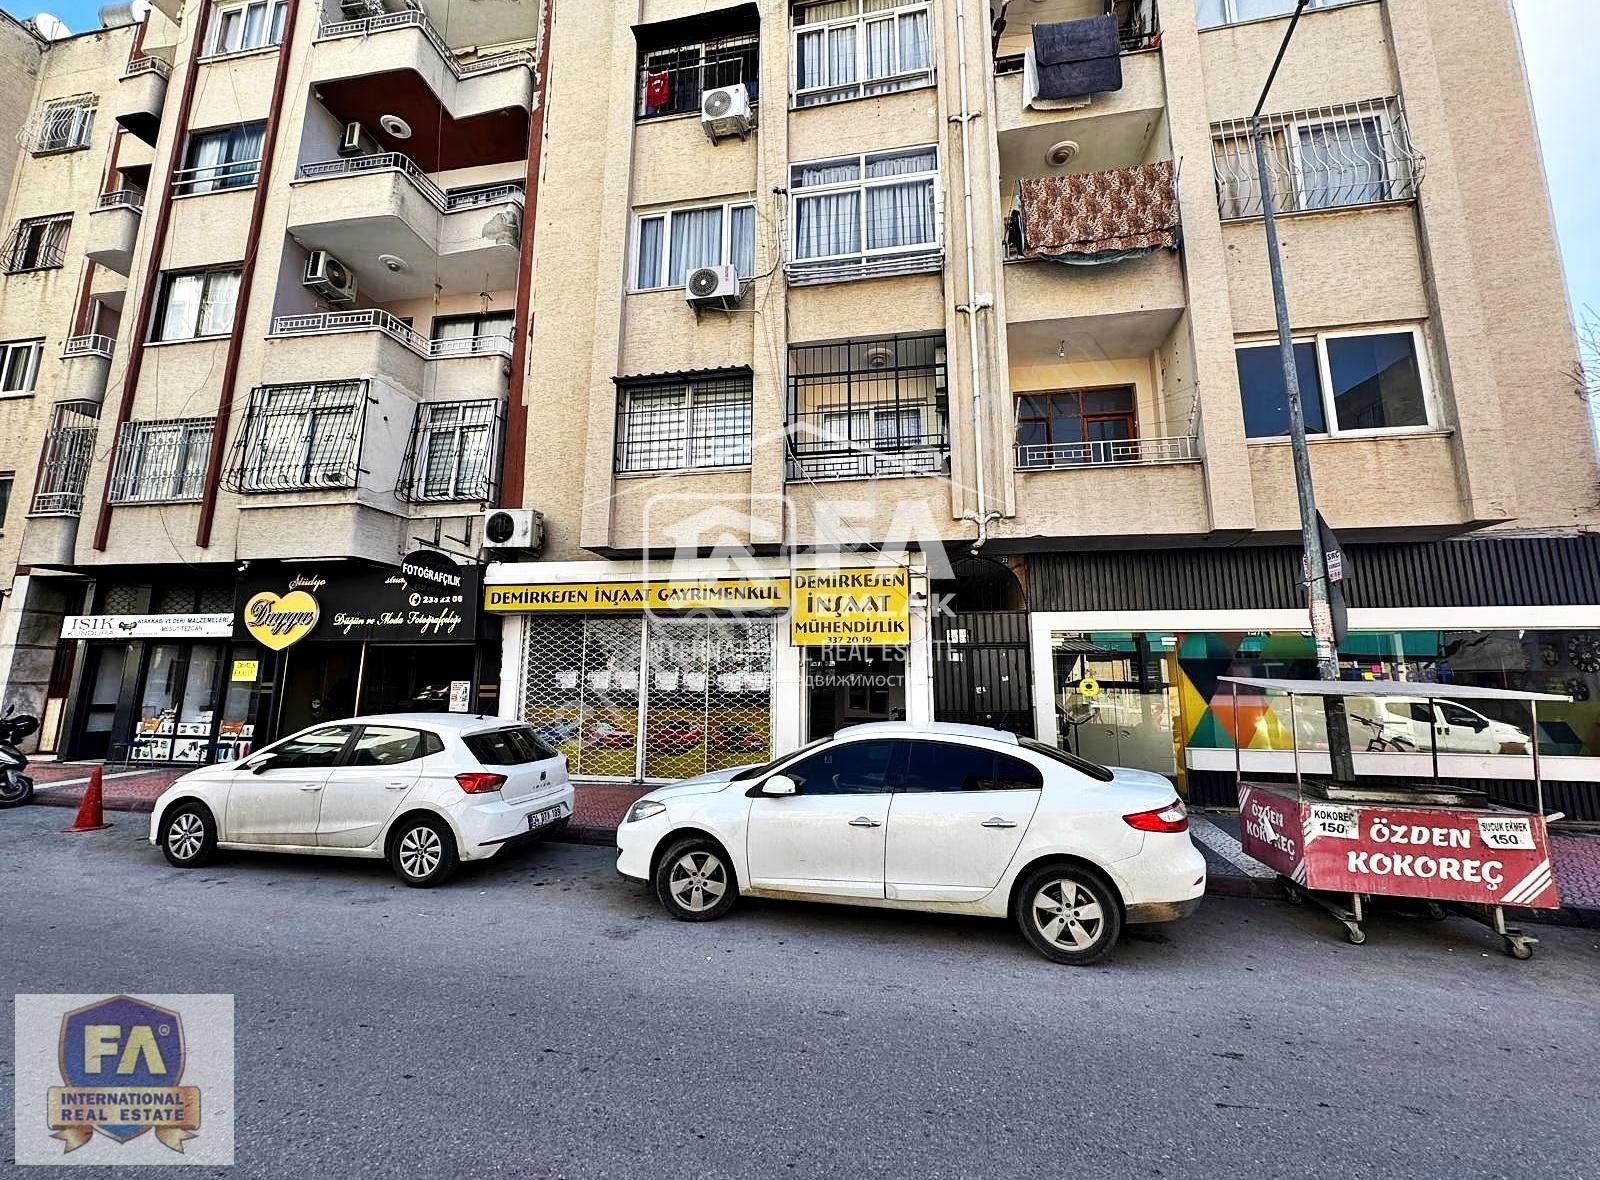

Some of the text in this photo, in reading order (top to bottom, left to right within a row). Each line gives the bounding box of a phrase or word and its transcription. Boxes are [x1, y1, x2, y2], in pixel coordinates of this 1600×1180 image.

[402, 563, 461, 587] FOTOĞRAFÇILIK
[795, 572, 905, 589] DEMİRKESEN
[490, 585, 782, 606] DEMİRKESEN İNŞAAT GAYRİMENKUL
[807, 592, 891, 617] İNŞAAT
[795, 618, 905, 633] MÜHENDİSLİK
[1319, 822, 1345, 833] 150
[1369, 817, 1471, 849] ÖZDEN
[1490, 834, 1519, 845] 150
[1347, 851, 1504, 890] KOKOREÇ
